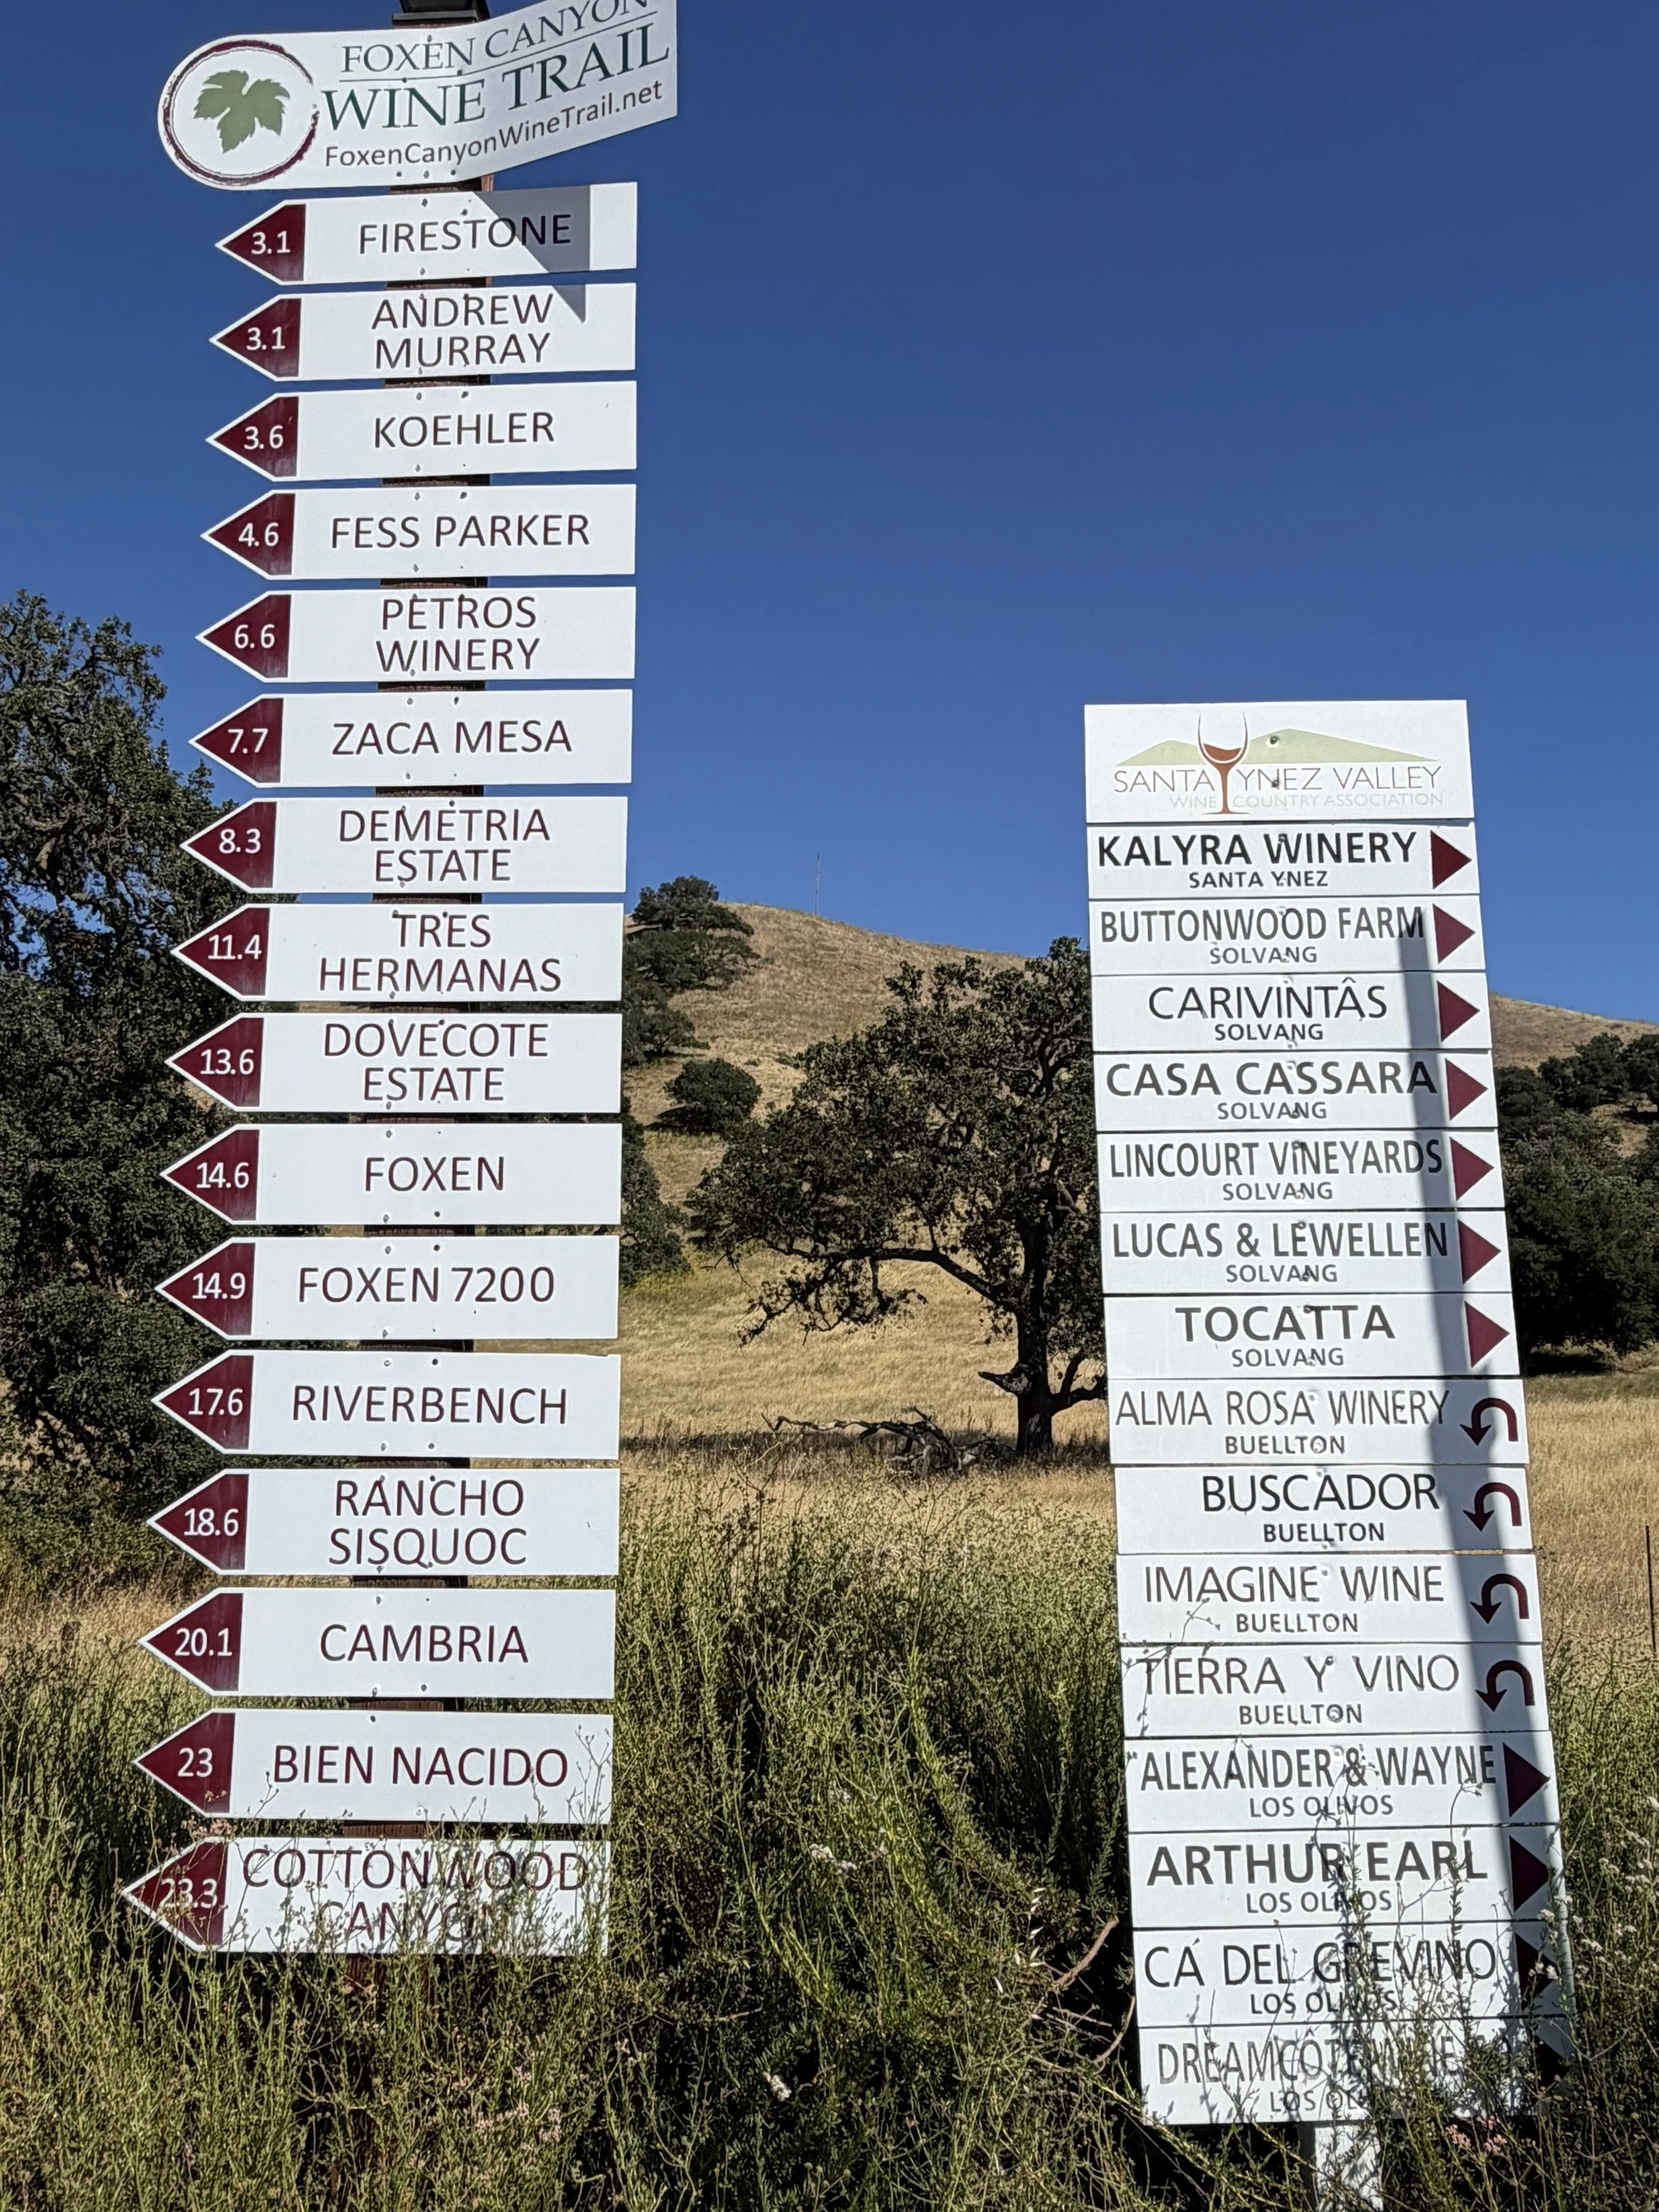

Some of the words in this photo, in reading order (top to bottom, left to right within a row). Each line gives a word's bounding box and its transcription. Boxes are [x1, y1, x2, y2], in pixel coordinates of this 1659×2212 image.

[342, 37, 476, 73] FOXEN
[322, 79, 486, 131] WINE
[502, 23, 670, 110] TRAIL
[326, 80, 662, 167] FoxenCanyonWineTrail.net
[251, 232, 290, 255] 3.1
[360, 214, 572, 255] FIRESTONE
[371, 293, 554, 330] ANDREW
[246, 327, 286, 352] 3.1
[375, 332, 551, 369] MURRAY
[244, 425, 284, 451] 3.6
[374, 412, 555, 448] KOEHLER
[238, 522, 279, 547] 4.6
[332, 516, 421, 549] FESS
[435, 514, 590, 547] PARKER
[382, 597, 536, 630] PETROS
[234, 623, 275, 649] 6.6
[376, 637, 541, 672] WINERY
[227, 728, 269, 754] 7.7
[331, 721, 440, 756] ZACA
[455, 719, 573, 754] MESA
[1114, 769, 1215, 793] SANTA
[1236, 767, 1323, 791] YNEZ
[1333, 766, 1441, 790] VALLEY
[1169, 796, 1218, 809] WINE
[1233, 794, 1321, 808] COUNTRY
[1324, 792, 1443, 806] ASSOCIATION
[218, 828, 261, 855] 8.3
[340, 808, 551, 842] DEMETRIA
[375, 849, 511, 882] ESTATE
[1098, 834, 1251, 867] KALYRA
[1264, 831, 1417, 863] WINERY
[1189, 871, 1263, 889] SANTA
[1271, 870, 1329, 887] YNEZ
[398, 913, 491, 948] TRES
[1101, 907, 1327, 942] BUTTONWOOD
[1338, 906, 1425, 939] FARM
[207, 934, 262, 961] 11.4
[1210, 946, 1318, 964] SOLVANG
[319, 957, 561, 993] HERMANAS
[1148, 978, 1388, 1020] CARIVINTÂS
[325, 1023, 549, 1058] DOVECOTE
[1214, 1023, 1324, 1041] SOLVANG
[200, 1049, 255, 1076] 13.6
[1106, 1063, 1222, 1097] CASA
[1236, 1061, 1437, 1095] CASSARA
[364, 1067, 504, 1102] ESTATE
[1217, 1102, 1327, 1120] SOLVANG
[196, 1163, 250, 1189] 14.6
[365, 1155, 504, 1191] FOXEN
[1110, 1142, 1260, 1178] LINCOURT
[1268, 1140, 1443, 1175] VINEYARDS
[1222, 1182, 1333, 1201] SOLVANG
[1113, 1222, 1222, 1258] LUCAS
[1236, 1222, 1261, 1257] &
[1273, 1221, 1448, 1256] LEWELLEN
[192, 1273, 246, 1299] 14.9
[299, 1266, 439, 1302] FOXEN
[451, 1266, 555, 1302] 7200
[1226, 1264, 1338, 1283] SOLVANG
[1175, 1305, 1396, 1343] TOCATTA
[1232, 1347, 1344, 1367] SOLVANG
[188, 1388, 244, 1416] 17.6
[293, 1386, 567, 1424] RIVERBENCH
[1116, 1391, 1212, 1426] ALMA
[1227, 1390, 1315, 1426] ROSA
[1328, 1390, 1450, 1426] WINERY
[1225, 1436, 1345, 1455] BUELLTON
[336, 1480, 525, 1517] RANCHO
[1202, 1474, 1440, 1512] BUSCADOR
[183, 1508, 239, 1537] 18.6
[1264, 1522, 1384, 1542] BUELLTON
[328, 1528, 527, 1568] SISQUOC
[1145, 1566, 1320, 1603] IMAGINE
[1340, 1566, 1444, 1601] WINE
[1236, 1613, 1358, 1633] BUELLTON
[175, 1628, 233, 1657] 20.1
[320, 1624, 528, 1664] CAMBRIA
[1136, 1657, 1286, 1694] TIERRA
[1304, 1657, 1331, 1692] Y
[1352, 1655, 1459, 1693] VINO
[1239, 1704, 1362, 1725] BUELLTON
[177, 1747, 214, 1777] 23
[273, 1745, 374, 1785] BIEN
[392, 1746, 569, 1787] NACIDO
[1141, 1749, 1334, 1791] ALEXANDER
[1345, 1748, 1368, 1787] &
[1376, 1745, 1497, 1786] WAYNE
[1250, 1796, 1295, 1818] LOS
[1304, 1795, 1393, 1816] OLIVOS
[243, 1848, 587, 1890] COTTONWOOD
[1147, 1843, 1348, 1886] ARTHUR
[1366, 1840, 1487, 1881] EARL
[160, 1878, 218, 1909] 23.3
[1247, 1893, 1292, 1914] LOS
[1223, 1944, 1296, 1985] DEL
[1250, 1993, 1296, 2014] LOS
[1270, 2091, 1316, 2112] LOS
